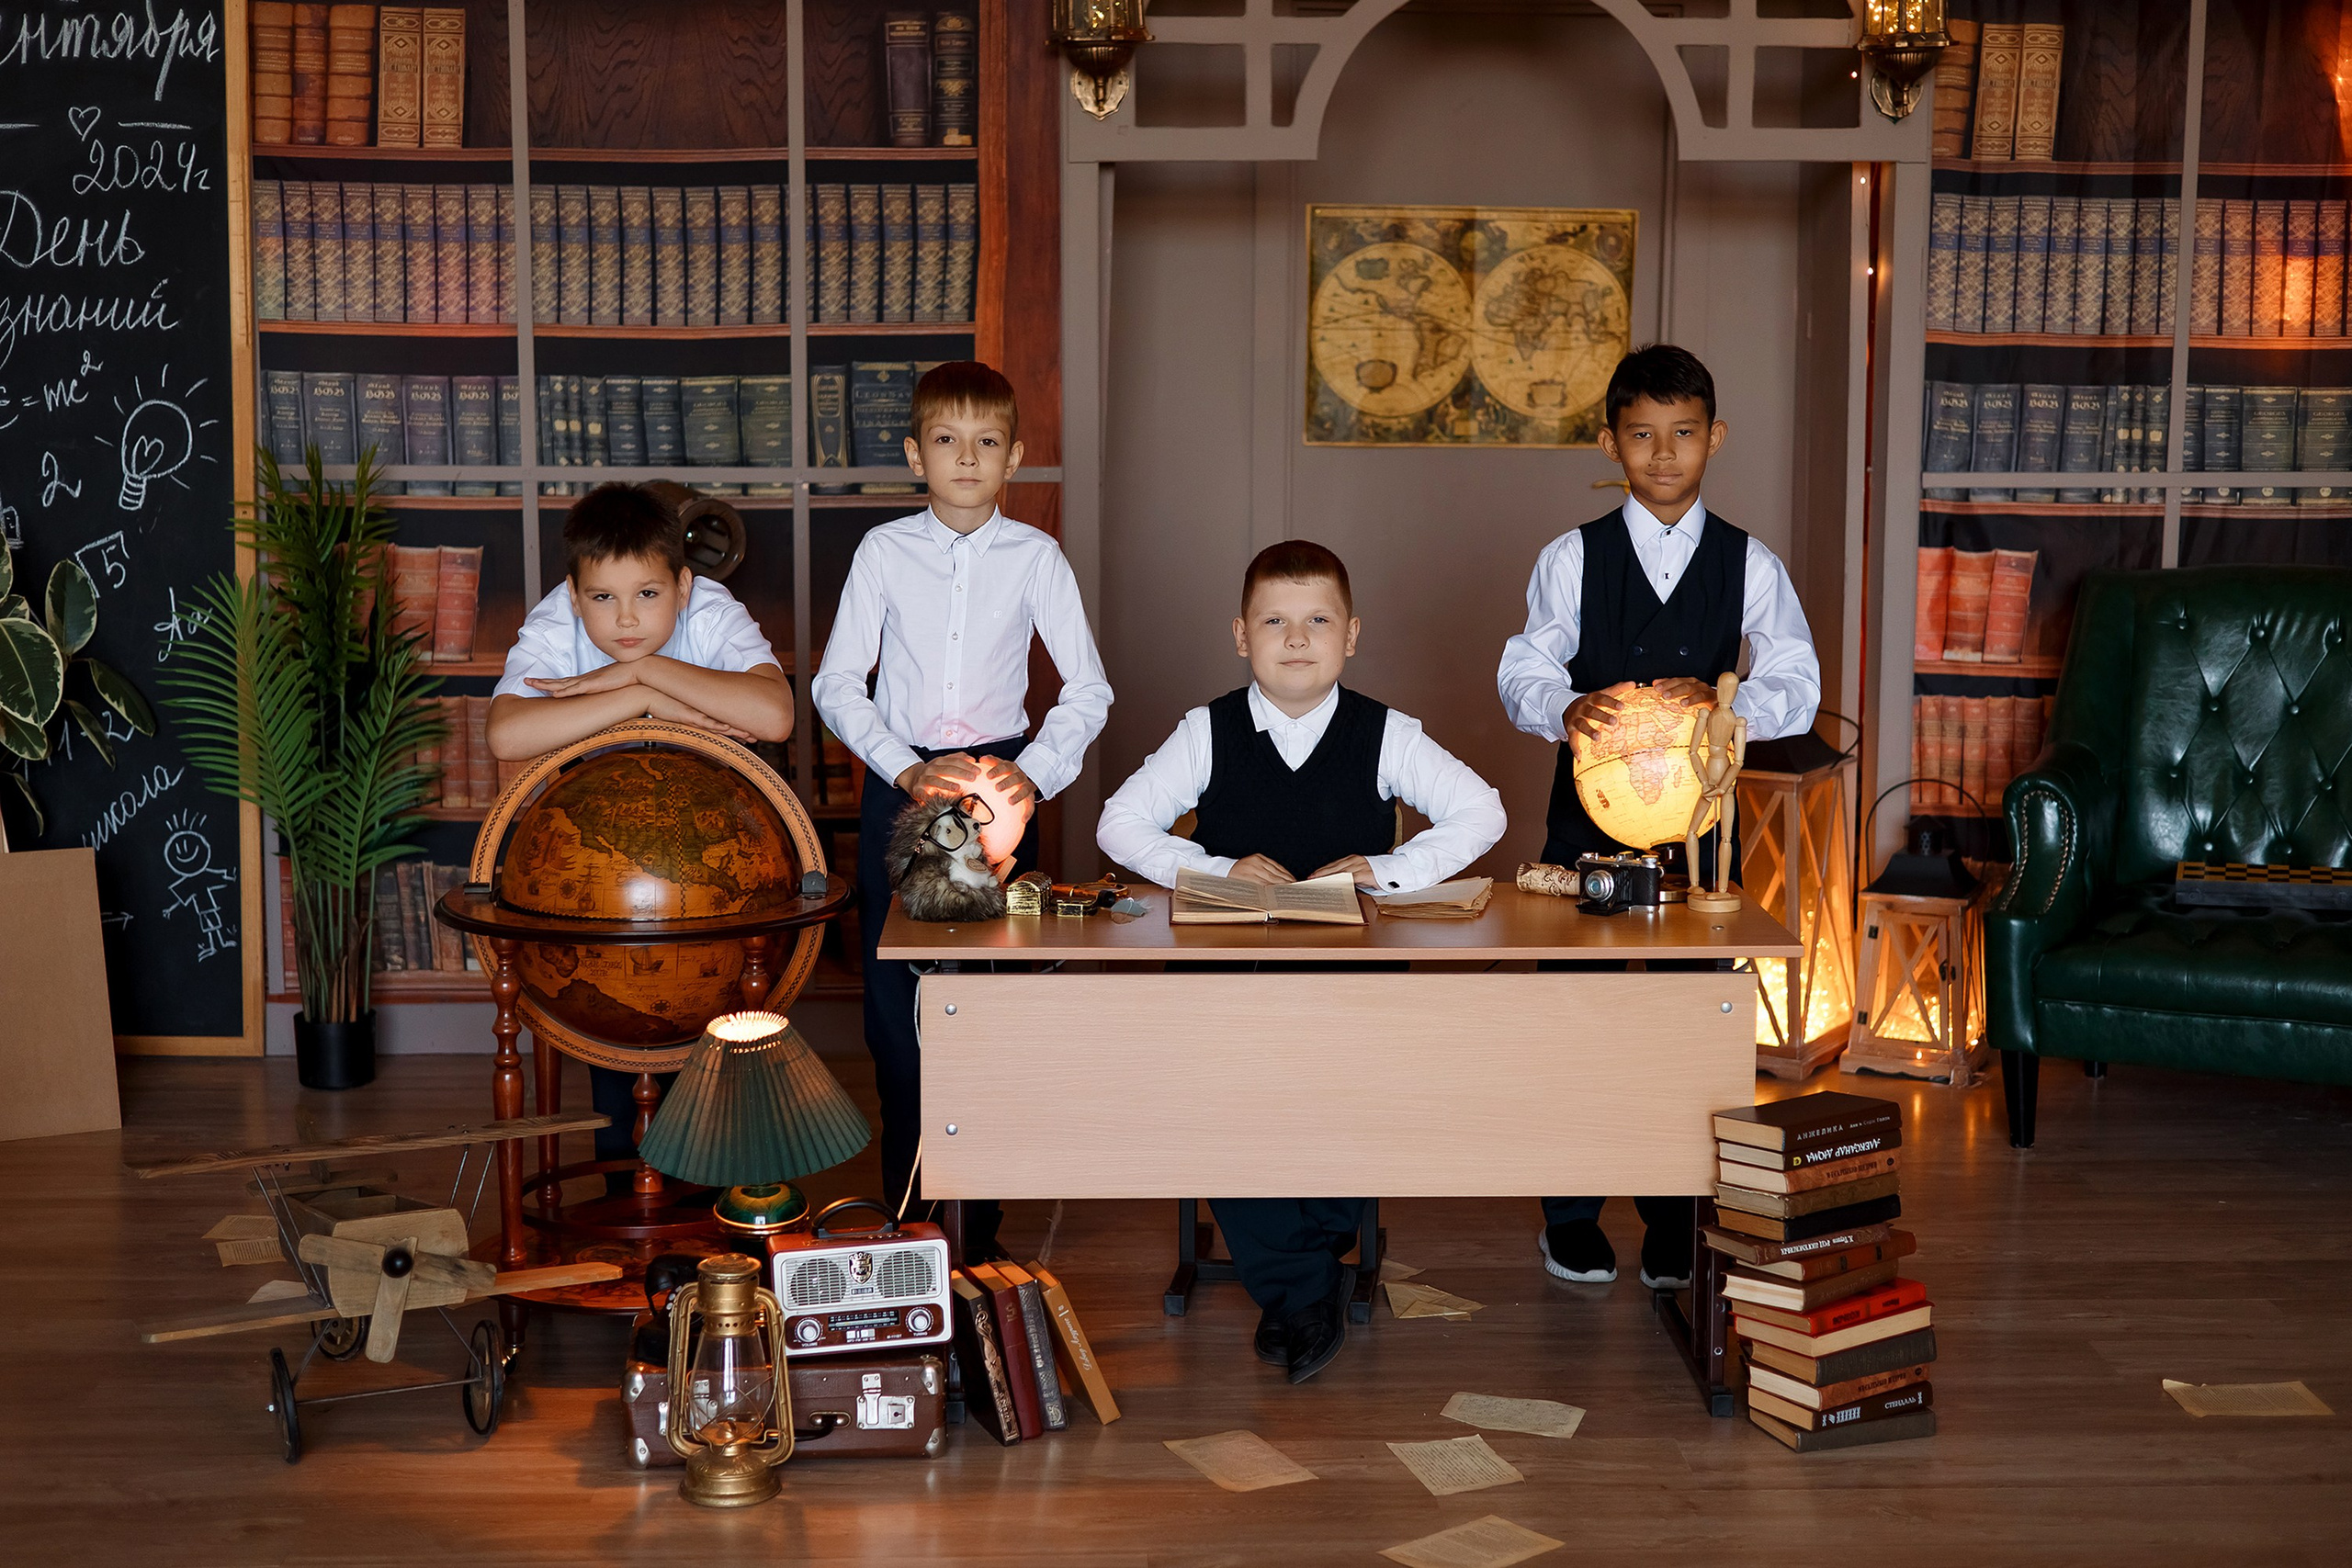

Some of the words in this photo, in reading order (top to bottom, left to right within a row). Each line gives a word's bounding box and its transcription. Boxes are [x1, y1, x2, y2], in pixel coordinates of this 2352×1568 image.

[0, 0, 220, 101] нтября
[0, 189, 145, 268] День
[41, 451, 82, 507] 2
[1797, 1124, 1844, 1141] АНЖЕЛИКА
[1805, 1148, 1833, 1163] ДЮМА
[1835, 1138, 1881, 1157] АЛЕКСАНДР
[1884, 1396, 1917, 1409] СТЕНДАЛЬ
